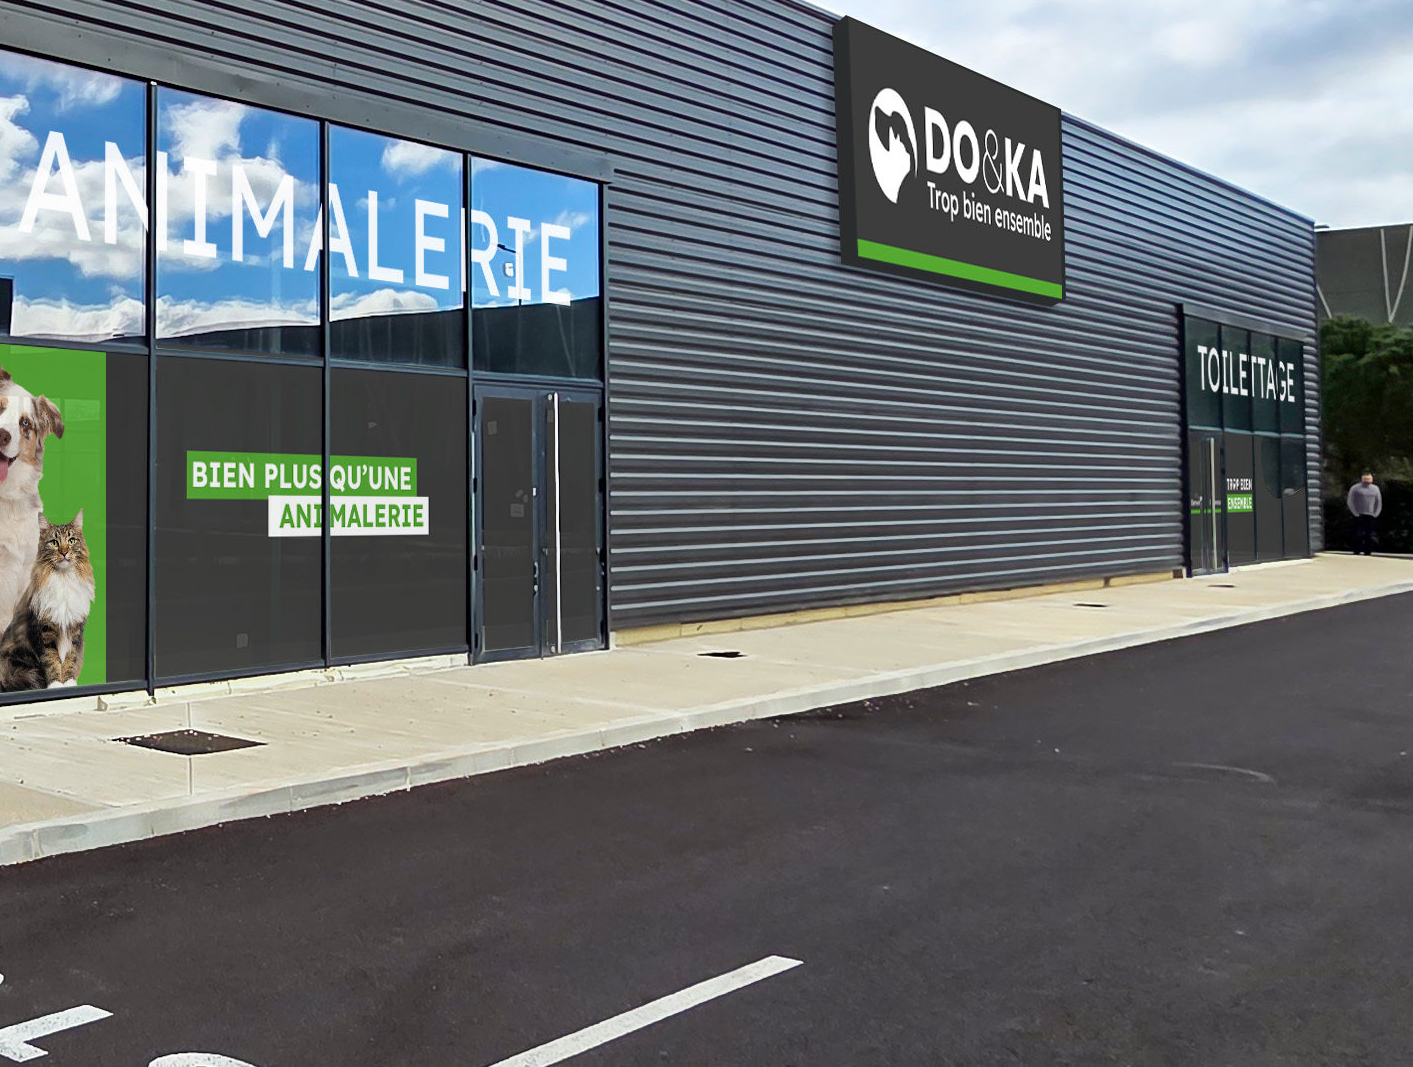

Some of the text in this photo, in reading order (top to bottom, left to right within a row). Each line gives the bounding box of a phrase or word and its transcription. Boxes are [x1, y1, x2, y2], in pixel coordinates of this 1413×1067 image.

[924, 106, 1050, 209] DO&KA
[19, 130, 572, 307] ANIMALERIE
[927, 181, 1051, 241] Trop bien ensemble
[1197, 345, 1295, 403] TOILETTAGE
[192, 461, 255, 489] BIEN
[265, 463, 322, 490] PLUS
[279, 504, 424, 529] ANIMALERIE
